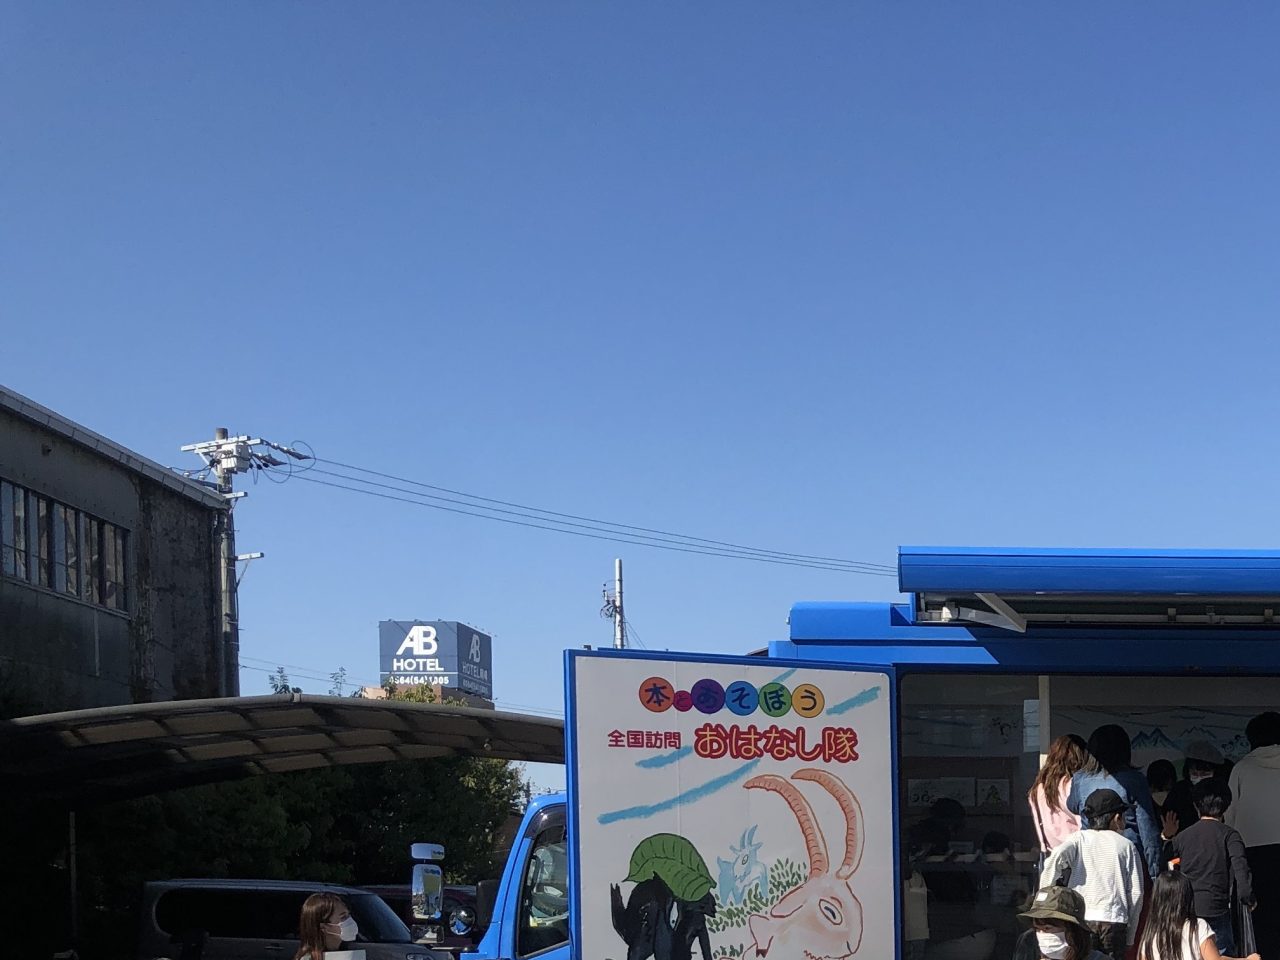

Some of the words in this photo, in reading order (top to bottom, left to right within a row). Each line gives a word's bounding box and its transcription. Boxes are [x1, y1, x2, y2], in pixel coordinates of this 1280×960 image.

[396, 625, 438, 656] AB
[468, 634, 481, 662] AB
[393, 658, 444, 671] HOTEL
[643, 682, 820, 714] 本とあそぼう
[608, 729, 682, 750] 全国訪問
[694, 723, 859, 763] おはなし隊
